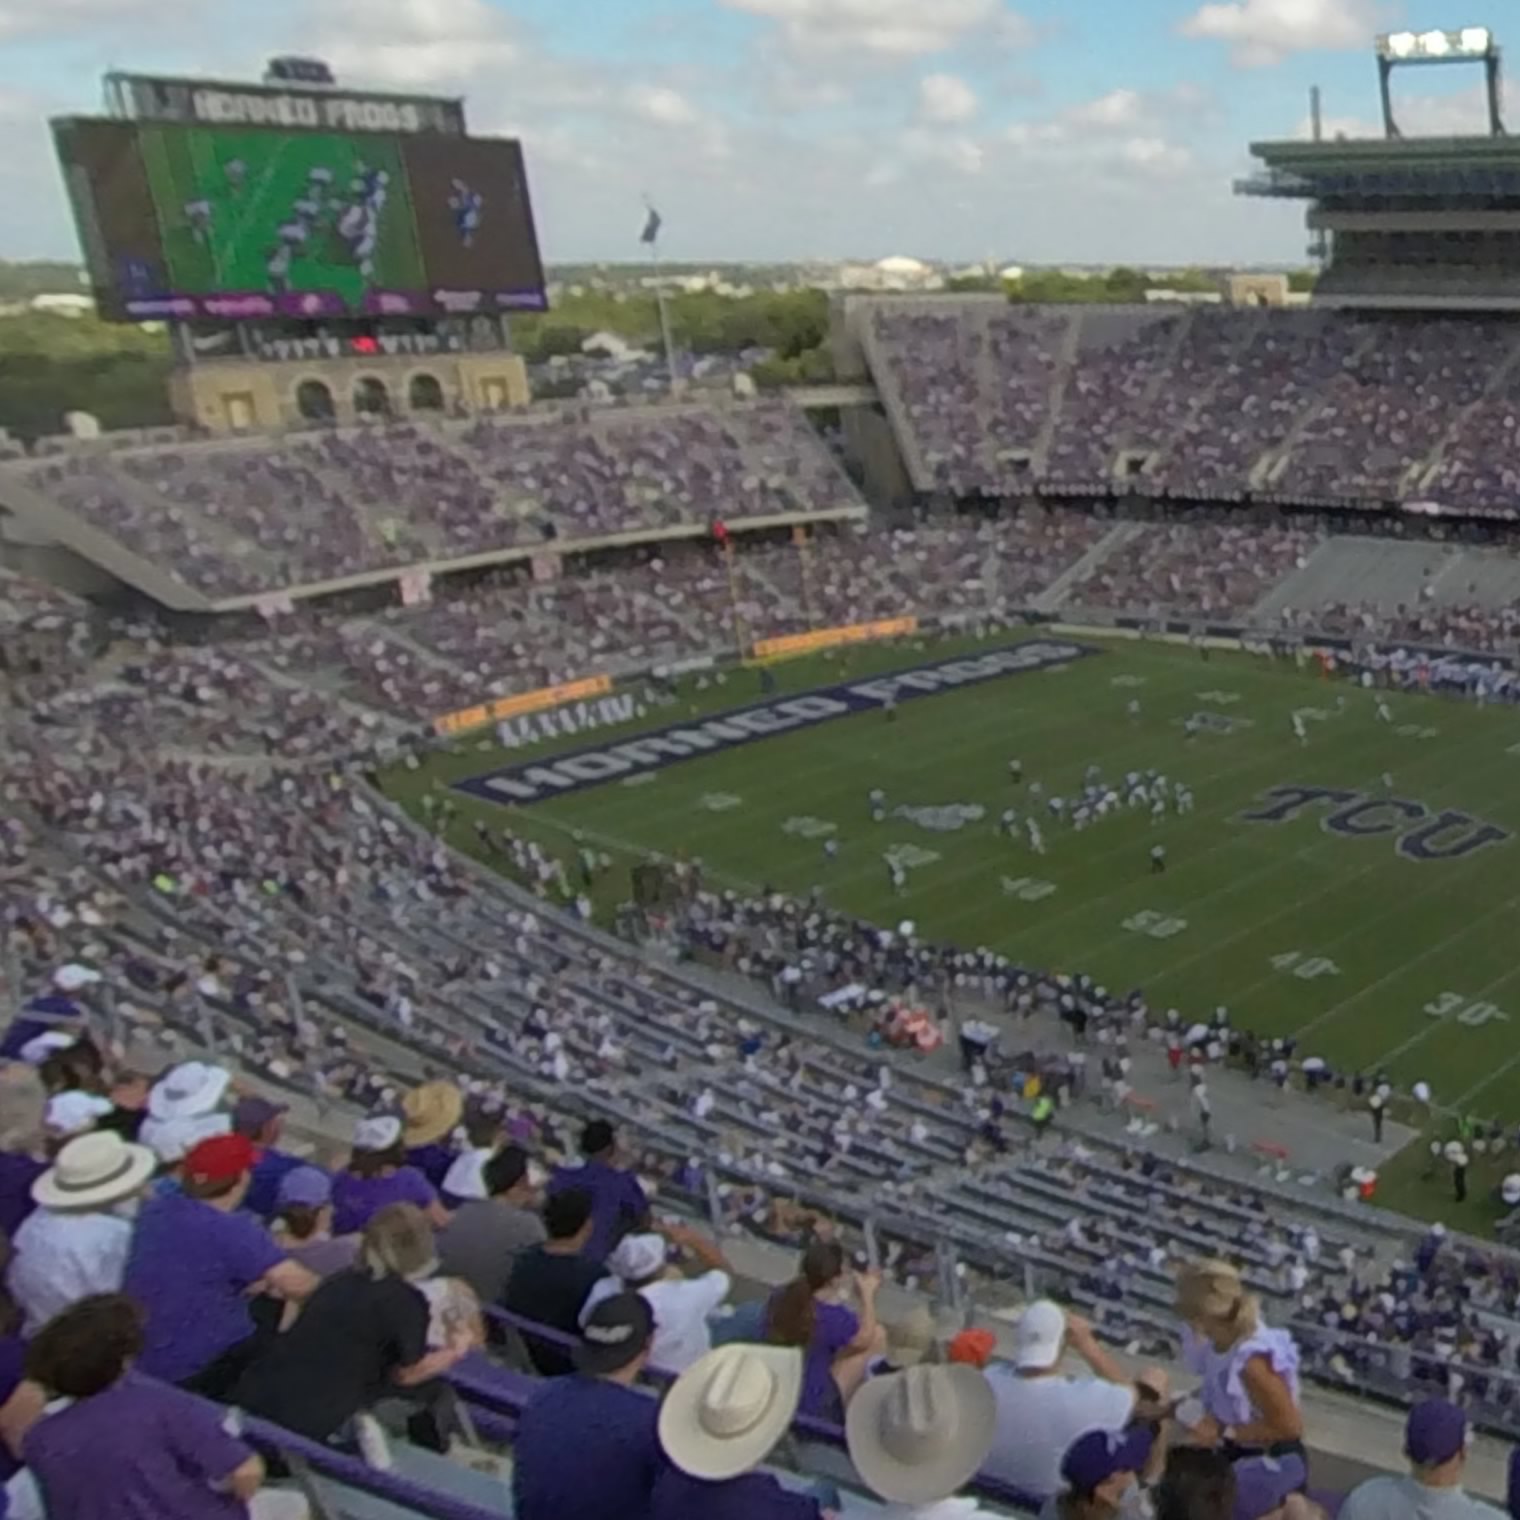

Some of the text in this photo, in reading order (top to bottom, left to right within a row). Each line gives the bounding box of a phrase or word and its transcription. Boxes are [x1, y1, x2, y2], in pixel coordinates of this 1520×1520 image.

[326, 100, 419, 133] FROGS
[487, 696, 848, 798] HORNED
[1239, 785, 1512, 861] TCU
[1423, 992, 1494, 1027] 30
